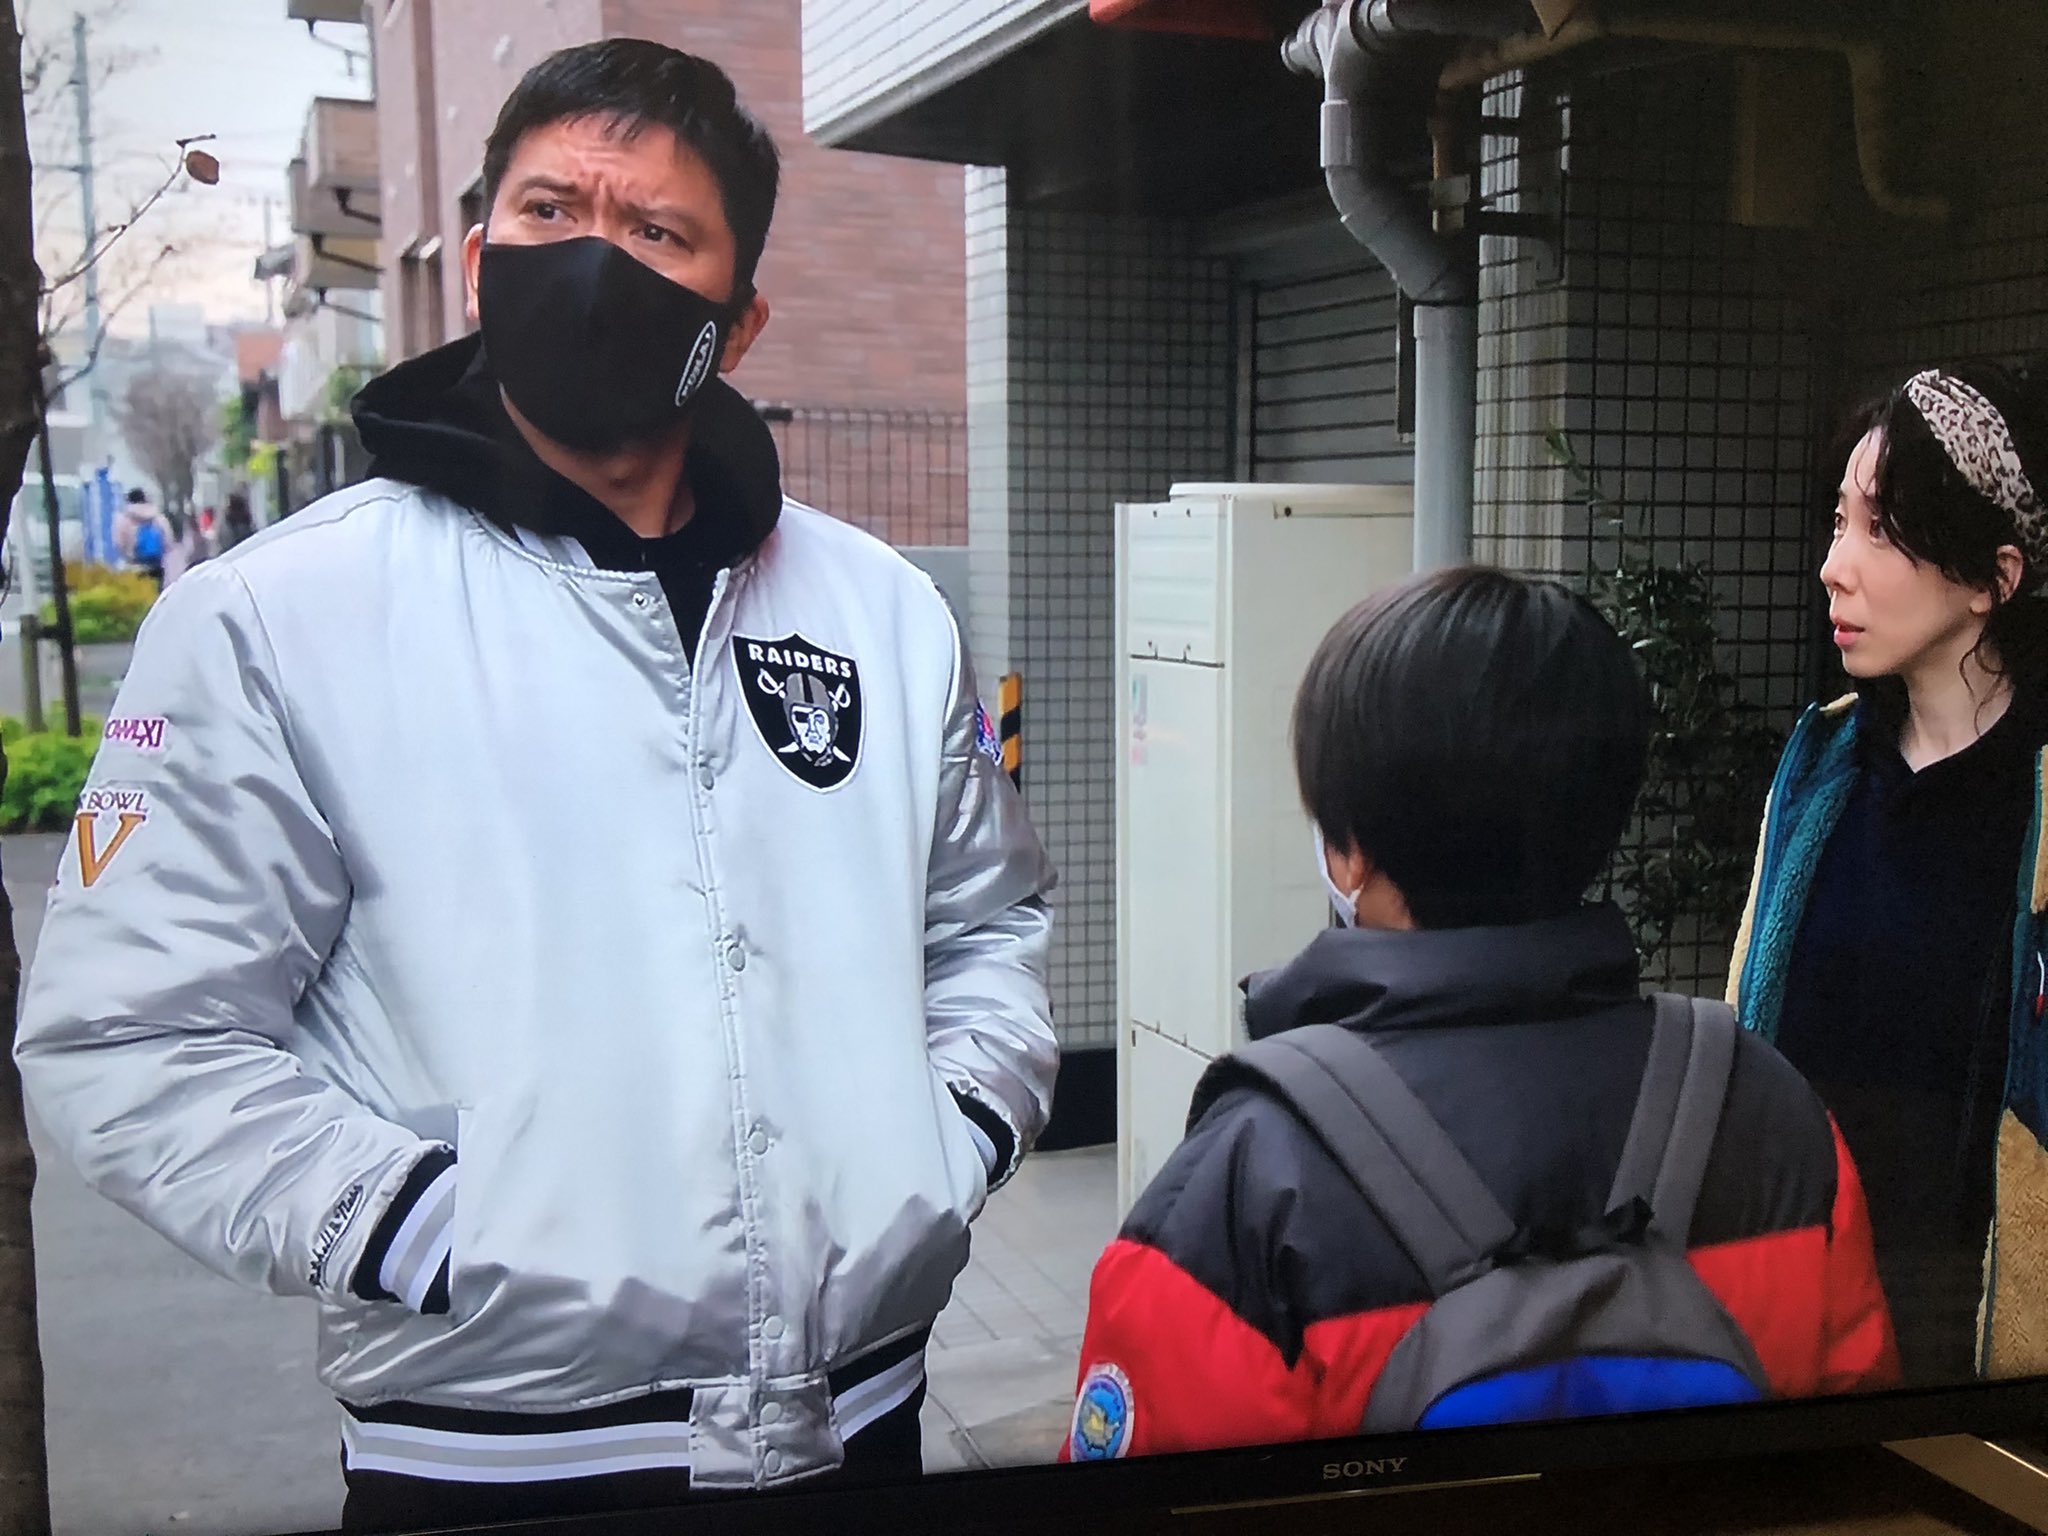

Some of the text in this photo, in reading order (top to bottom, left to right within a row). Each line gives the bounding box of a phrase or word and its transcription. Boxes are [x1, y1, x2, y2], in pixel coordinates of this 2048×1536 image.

[747, 643, 852, 679] RAIDERS
[86, 790, 149, 812] BOWL
[75, 811, 147, 888] V
[1322, 1456, 1408, 1480] SONY
